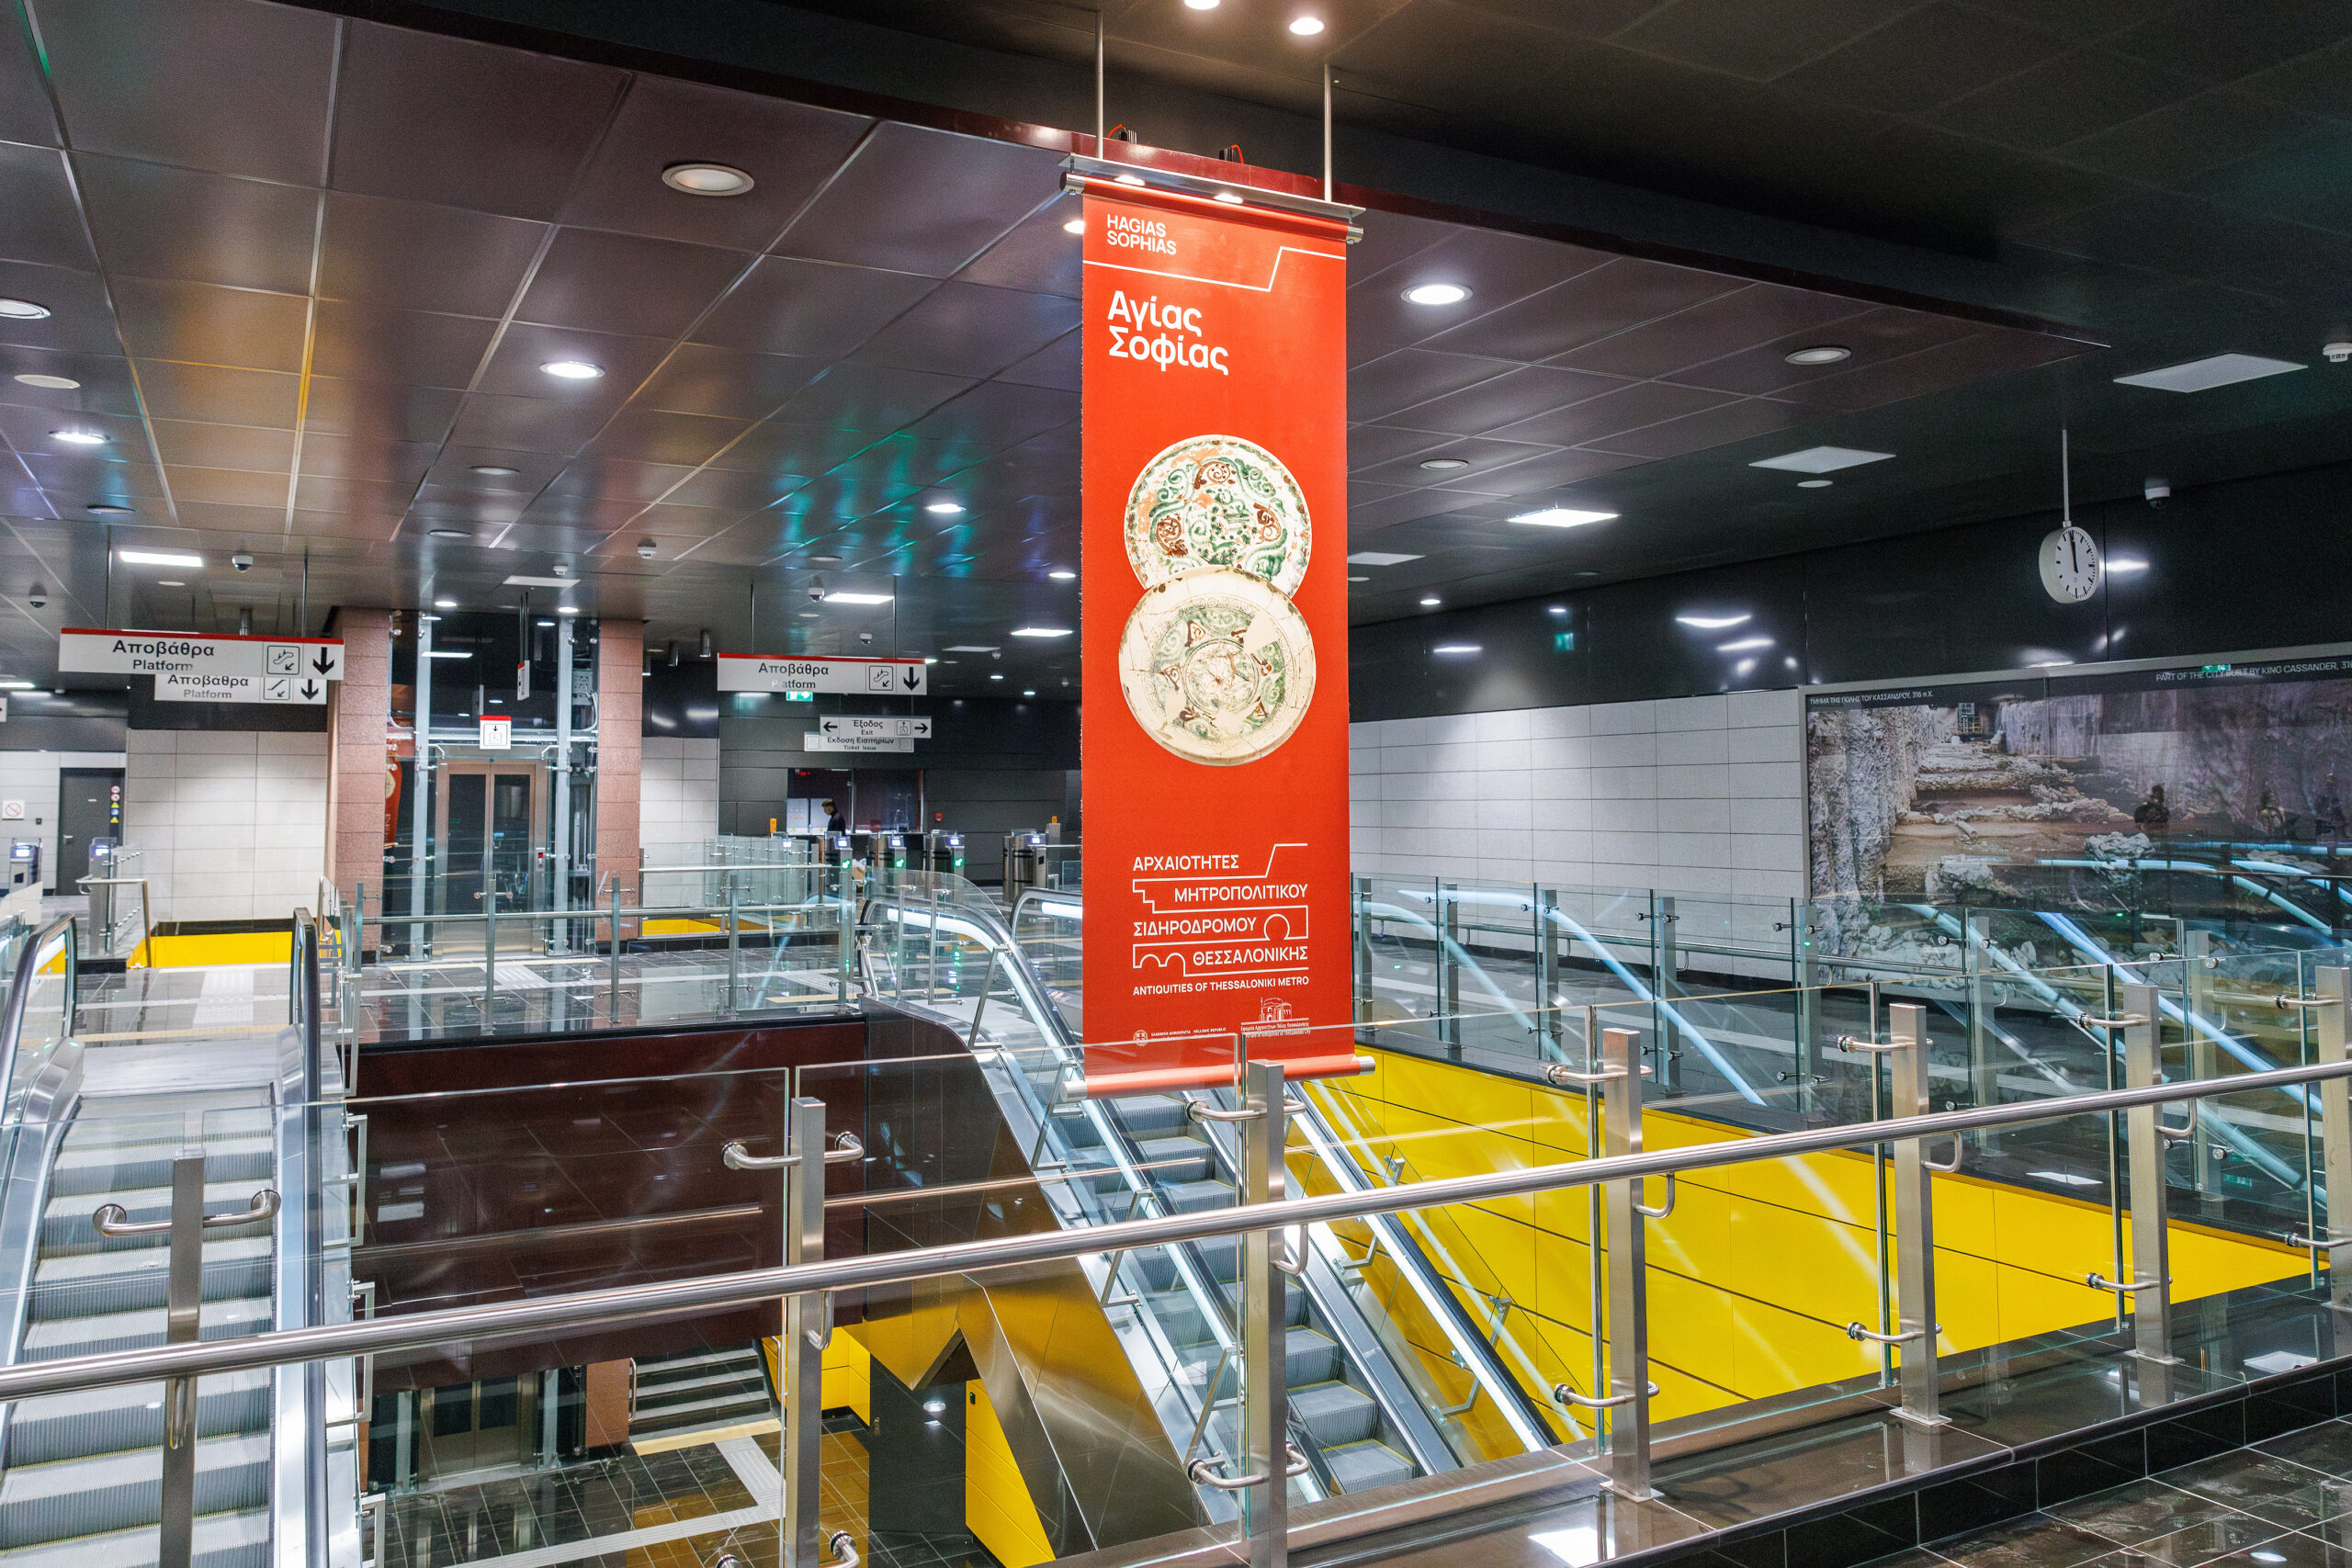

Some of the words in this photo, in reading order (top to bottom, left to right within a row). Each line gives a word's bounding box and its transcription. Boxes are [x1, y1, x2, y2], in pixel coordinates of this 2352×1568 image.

[1106, 213, 1167, 238] HAGIAS
[1106, 230, 1177, 255] SOPHIAS
[1107, 290, 1203, 337] Αγίας
[1108, 325, 1229, 376] Σοφίας
[112, 639, 215, 659] Αποβάθρα
[132, 660, 193, 671] Platform
[758, 662, 829, 677] Αποβάθρα
[2155, 671, 2175, 682] PART
[2177, 672, 2188, 681] OF
[2189, 671, 2204, 680] THE
[2249, 667, 2260, 676] BY
[2261, 665, 2282, 675] KING
[2283, 661, 2339, 673] CASSANDER,
[184, 689, 232, 699] Platform
[772, 679, 816, 689] Patform
[851, 719, 883, 728] Έξοδος
[1132, 854, 1239, 872] ΑΡΧΑΙΟΤΗΤΕΣ
[1174, 884, 1308, 903] ΜΗΤΡΟΠΟΛΙΤΙΚΟΥ
[1133, 917, 1257, 937] ΣΙΔΗΡΟΔΡΟΜΟΥ
[1193, 945, 1308, 966] ΘΕΣΣΑΛΟΝΙΚΗΣ
[1133, 983, 1193, 996] ANTIQUITIES
[1194, 982, 1208, 992] OF
[1210, 977, 1276, 991] THESSALONIKI
[1277, 976, 1309, 987] METRO
